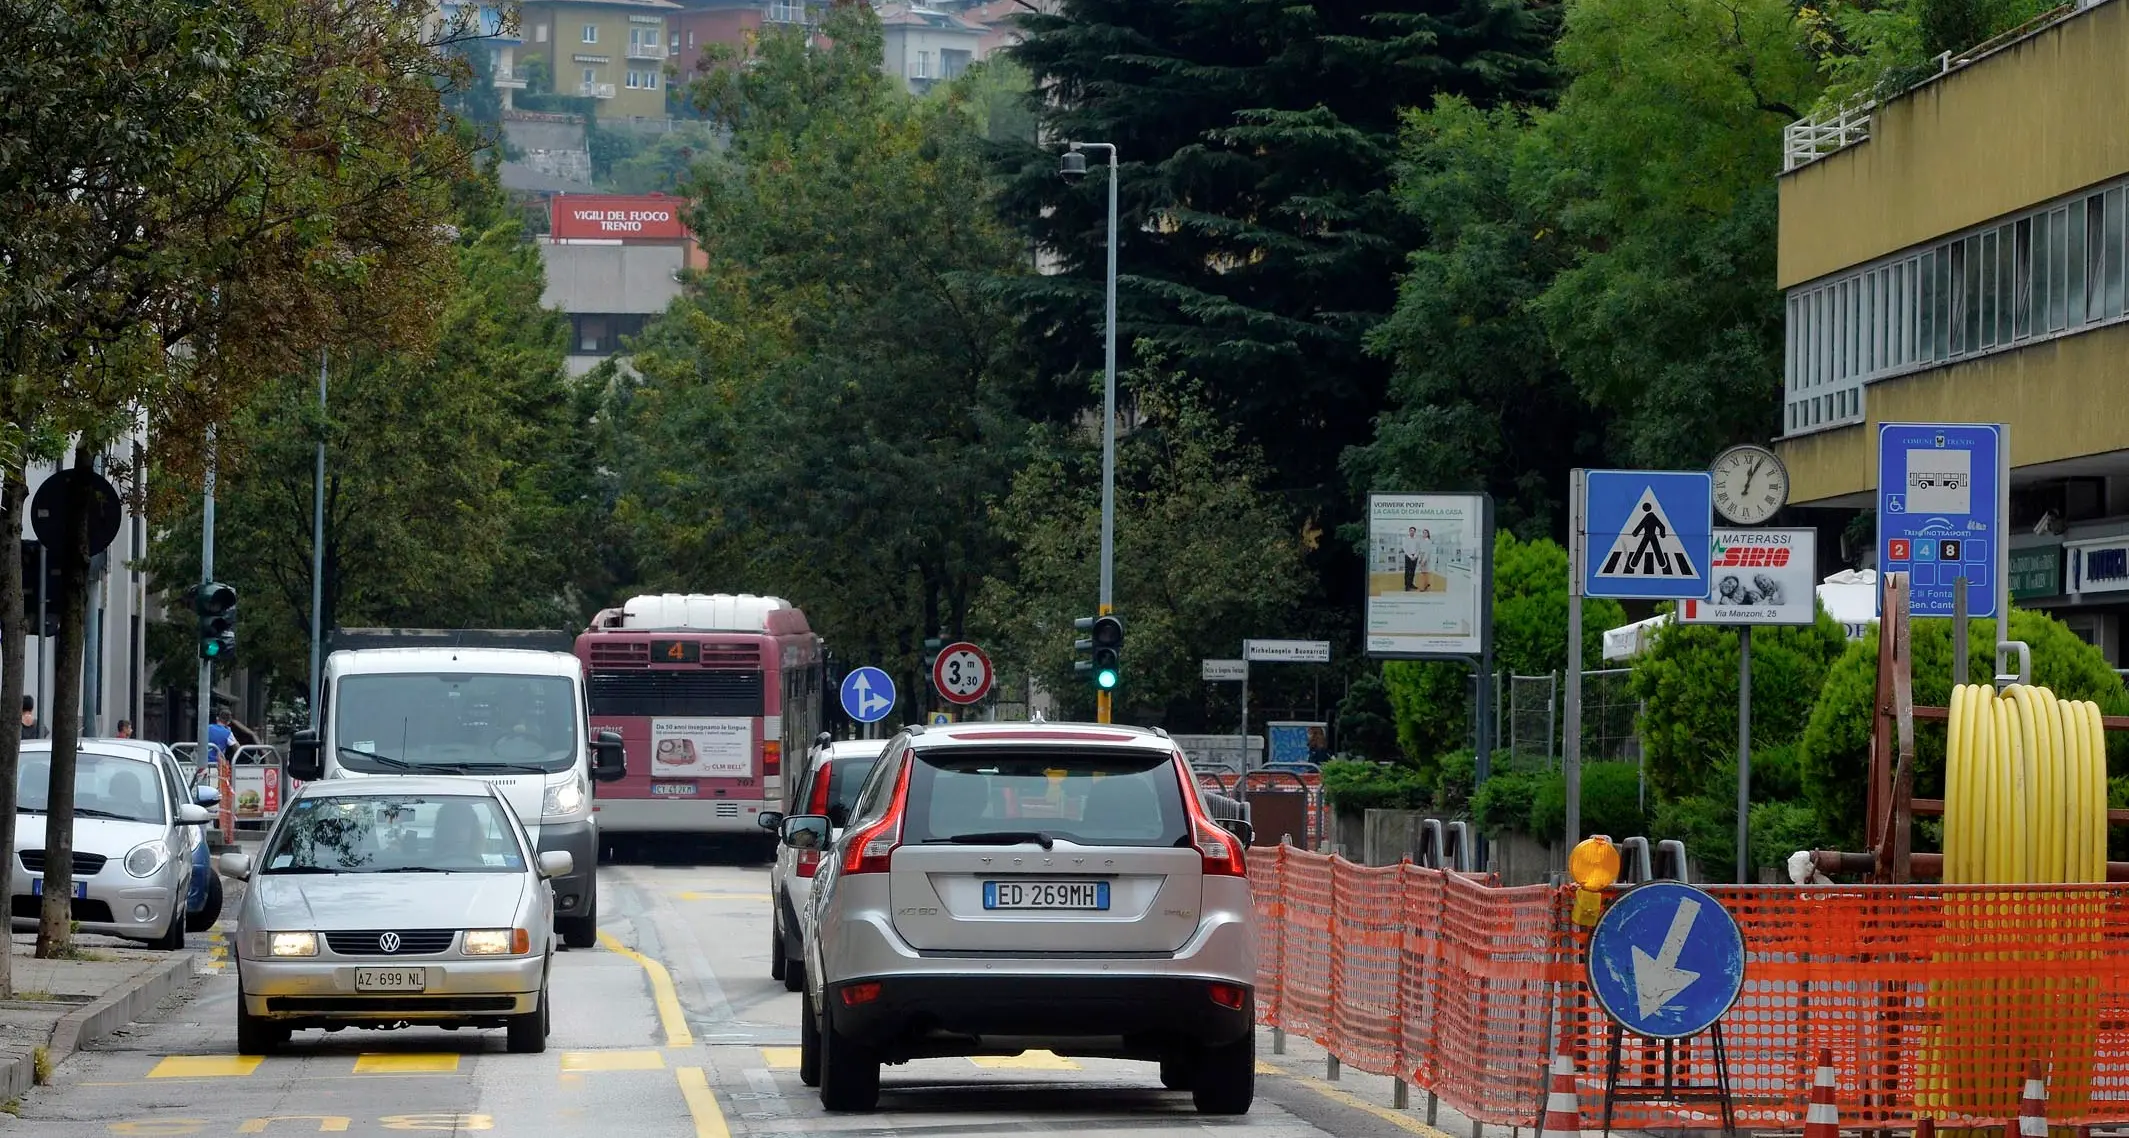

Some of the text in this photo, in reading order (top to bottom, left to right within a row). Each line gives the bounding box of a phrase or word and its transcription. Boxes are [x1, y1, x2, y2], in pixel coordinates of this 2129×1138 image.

[574, 210, 669, 221] VIGILI DEL FUOCO
[600, 221, 642, 231] TRENTO
[1722, 534, 1792, 544] MATERASSI
[1895, 544, 1955, 556] 2 4 8
[1719, 547, 1791, 567] SIRIO
[1927, 590, 1953, 598] Fonta
[1714, 610, 1727, 618] Via
[1767, 610, 1777, 618] 25
[668, 640, 684, 659] 4
[1251, 647, 1291, 655] Michelangelo
[998, 885, 1023, 906] ED
[1031, 885, 1094, 906] 269MH
[358, 973, 423, 986] AZ 699 NL
